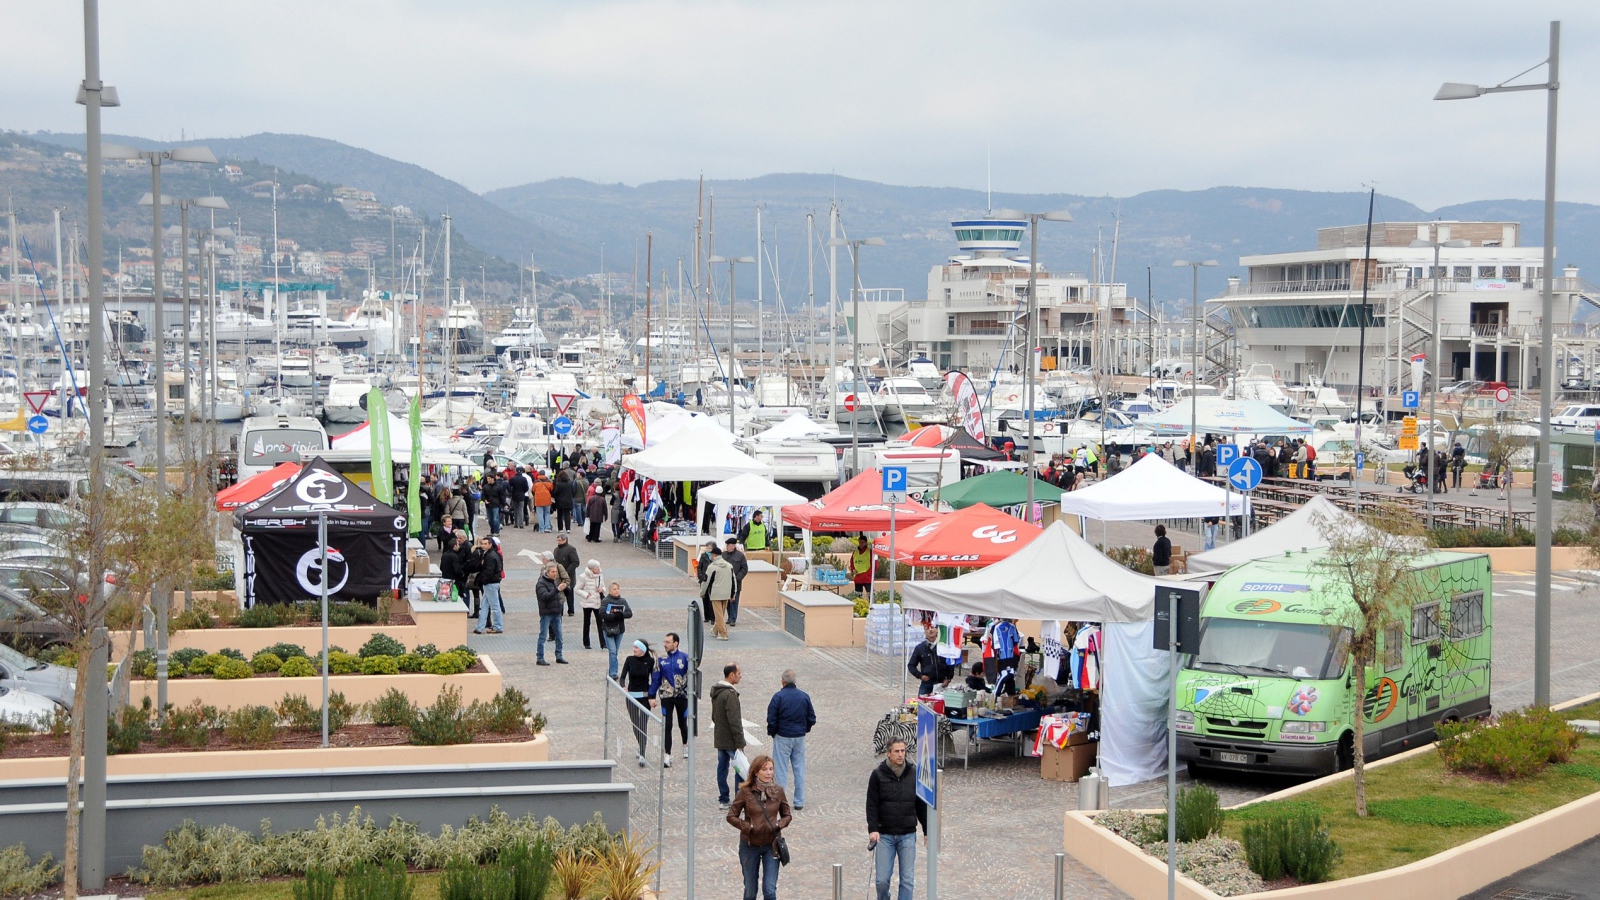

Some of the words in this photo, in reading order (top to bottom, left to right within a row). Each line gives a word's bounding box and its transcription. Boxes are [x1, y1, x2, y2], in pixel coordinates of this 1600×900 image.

[1405, 393, 1416, 406] P
[1220, 446, 1234, 464] P
[1357, 454, 1364, 468] P
[887, 469, 902, 489] P
[244, 518, 306, 527] HERSH
[391, 536, 404, 590] RSH
[919, 554, 949, 562] GAS
[950, 554, 981, 562] GAS
[1243, 583, 1284, 592] sprint
